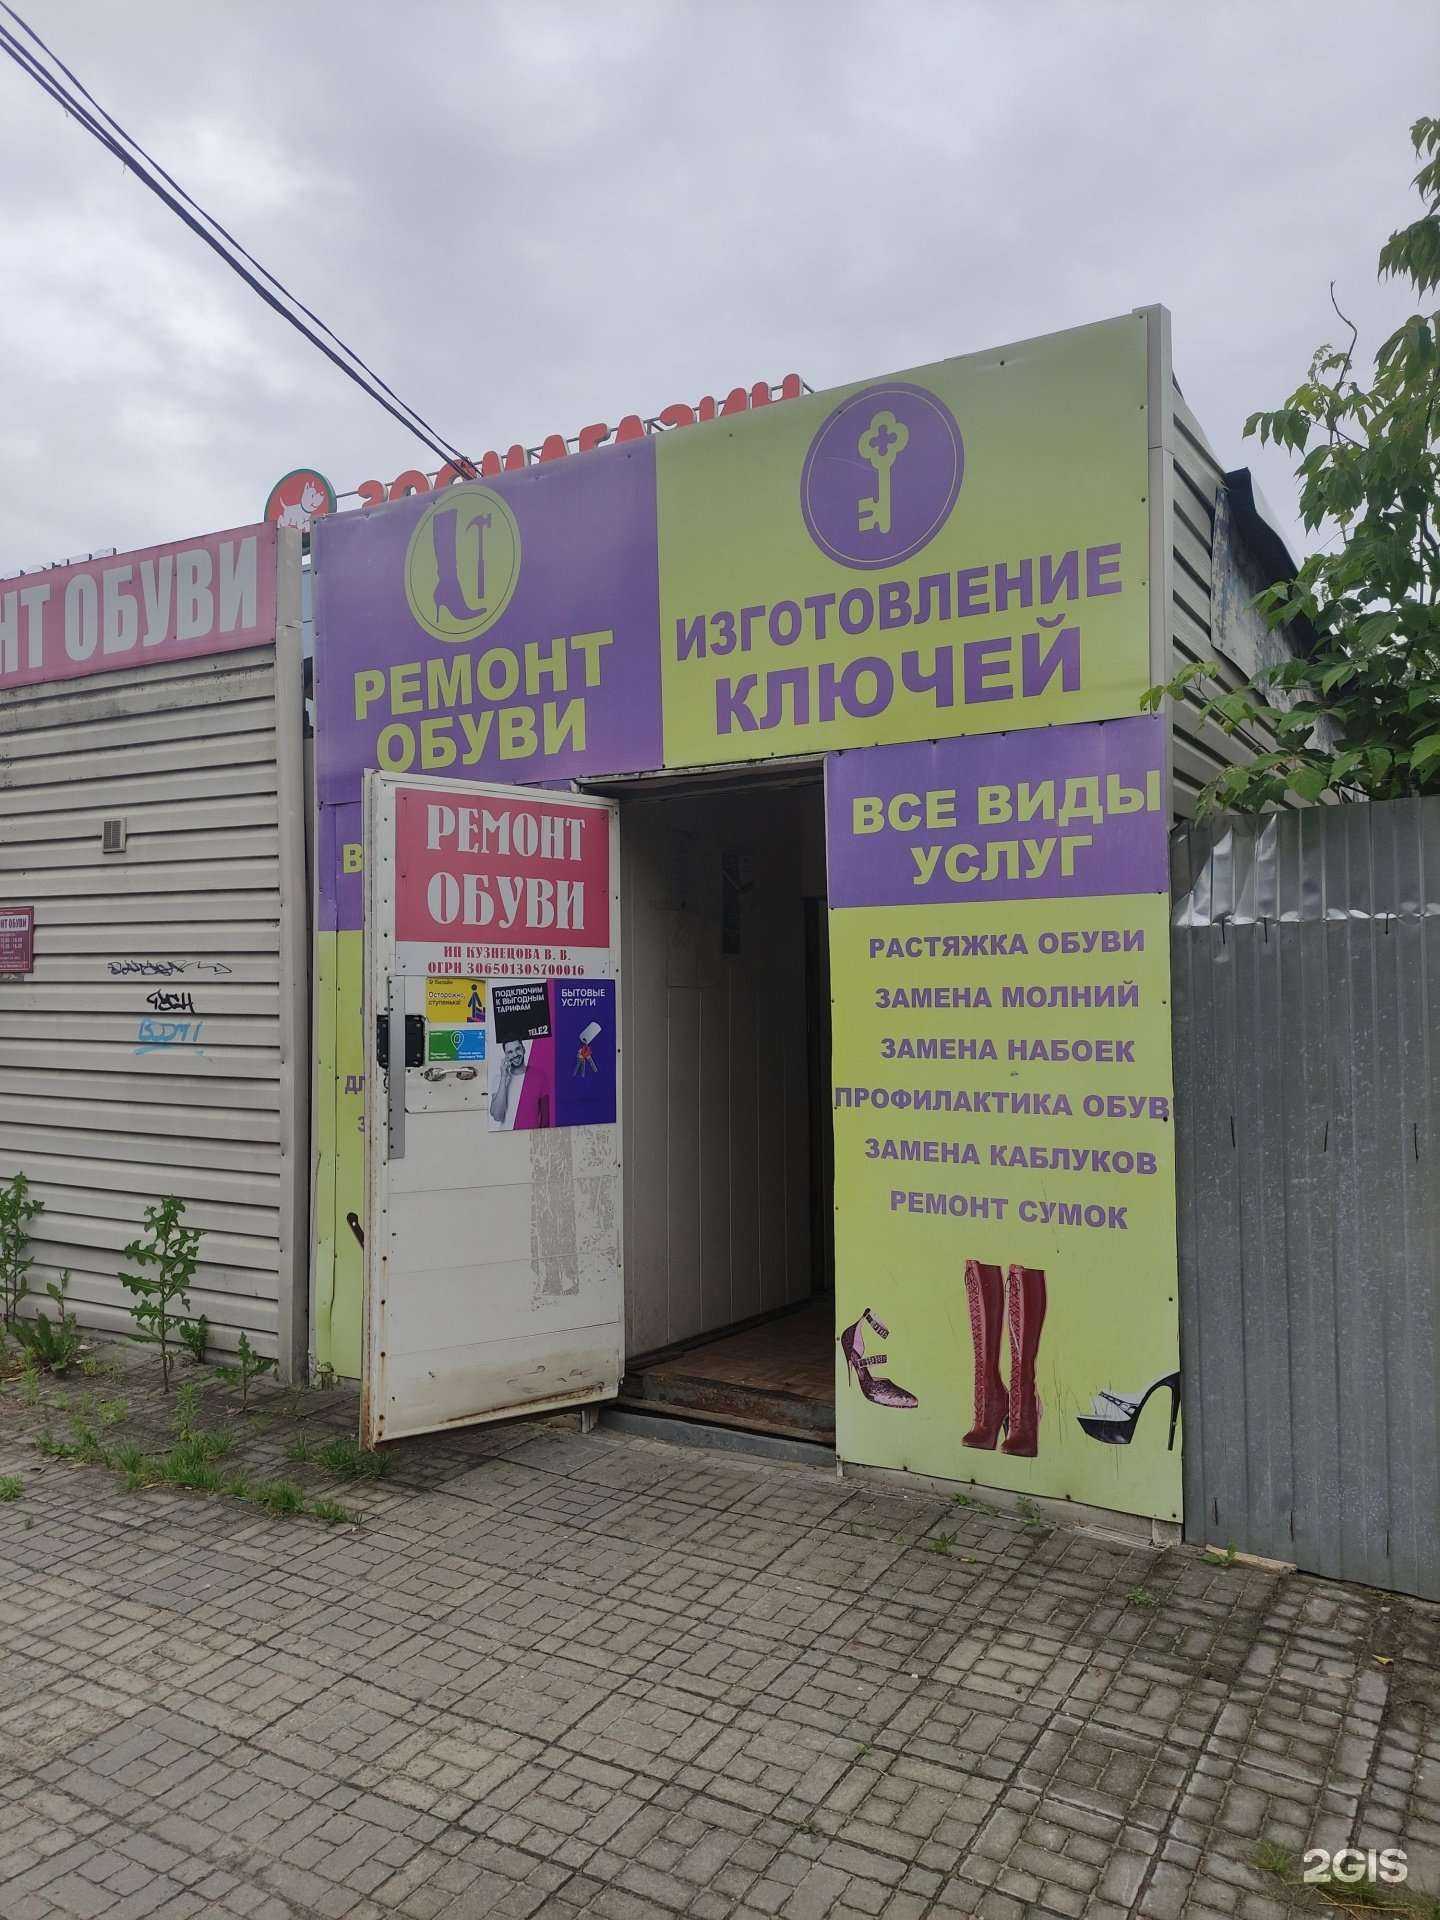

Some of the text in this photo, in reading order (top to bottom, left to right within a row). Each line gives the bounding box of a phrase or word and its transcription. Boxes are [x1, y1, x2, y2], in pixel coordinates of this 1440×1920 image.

[65, 536, 257, 661] ОБУВИ
[676, 542, 1122, 661] ИЗГОТОВЛЕНИЕ
[354, 630, 614, 721] РЕМОНТ
[715, 612, 1081, 735] КЛЮЧЕЙ
[376, 698, 587, 773] ОБУВИ
[852, 769, 1162, 835] ВСЕ ВИДЫ
[426, 804, 586, 861] РЕМОНТ
[911, 835, 1093, 885] УСЛУГ
[427, 871, 585, 930] ОБУВИ
[444, 946, 572, 961] ИП КУЗНЕЦОВА В. В.
[869, 929, 1145, 958] РАСТЯЖКА ОБУВИ
[428, 962, 585, 976] ОГРН 306501308700016
[495, 986, 543, 998] ПОДКЛЮЧИМ
[502, 994, 545, 1005] ВЫГОДНЫМ
[561, 988, 606, 998] БЫТОВЫЕ
[561, 998, 597, 1007] УСЛУГИ
[875, 980, 1139, 1008] ЗАМЕНА МОЛНИЙ
[496, 1004, 531, 1013] ТАРИФАМ
[528, 1025, 548, 1037] TELE2
[880, 1038, 1135, 1062] ЗАМЕНА НАБОЕК
[834, 1087, 1170, 1119] ПРОФИЛАКТИКА ОБУВ
[864, 1138, 1157, 1175] ЗАМЕНА КАБЛУКОВ
[890, 1190, 1128, 1230] РЕМОНТ СУМОК
